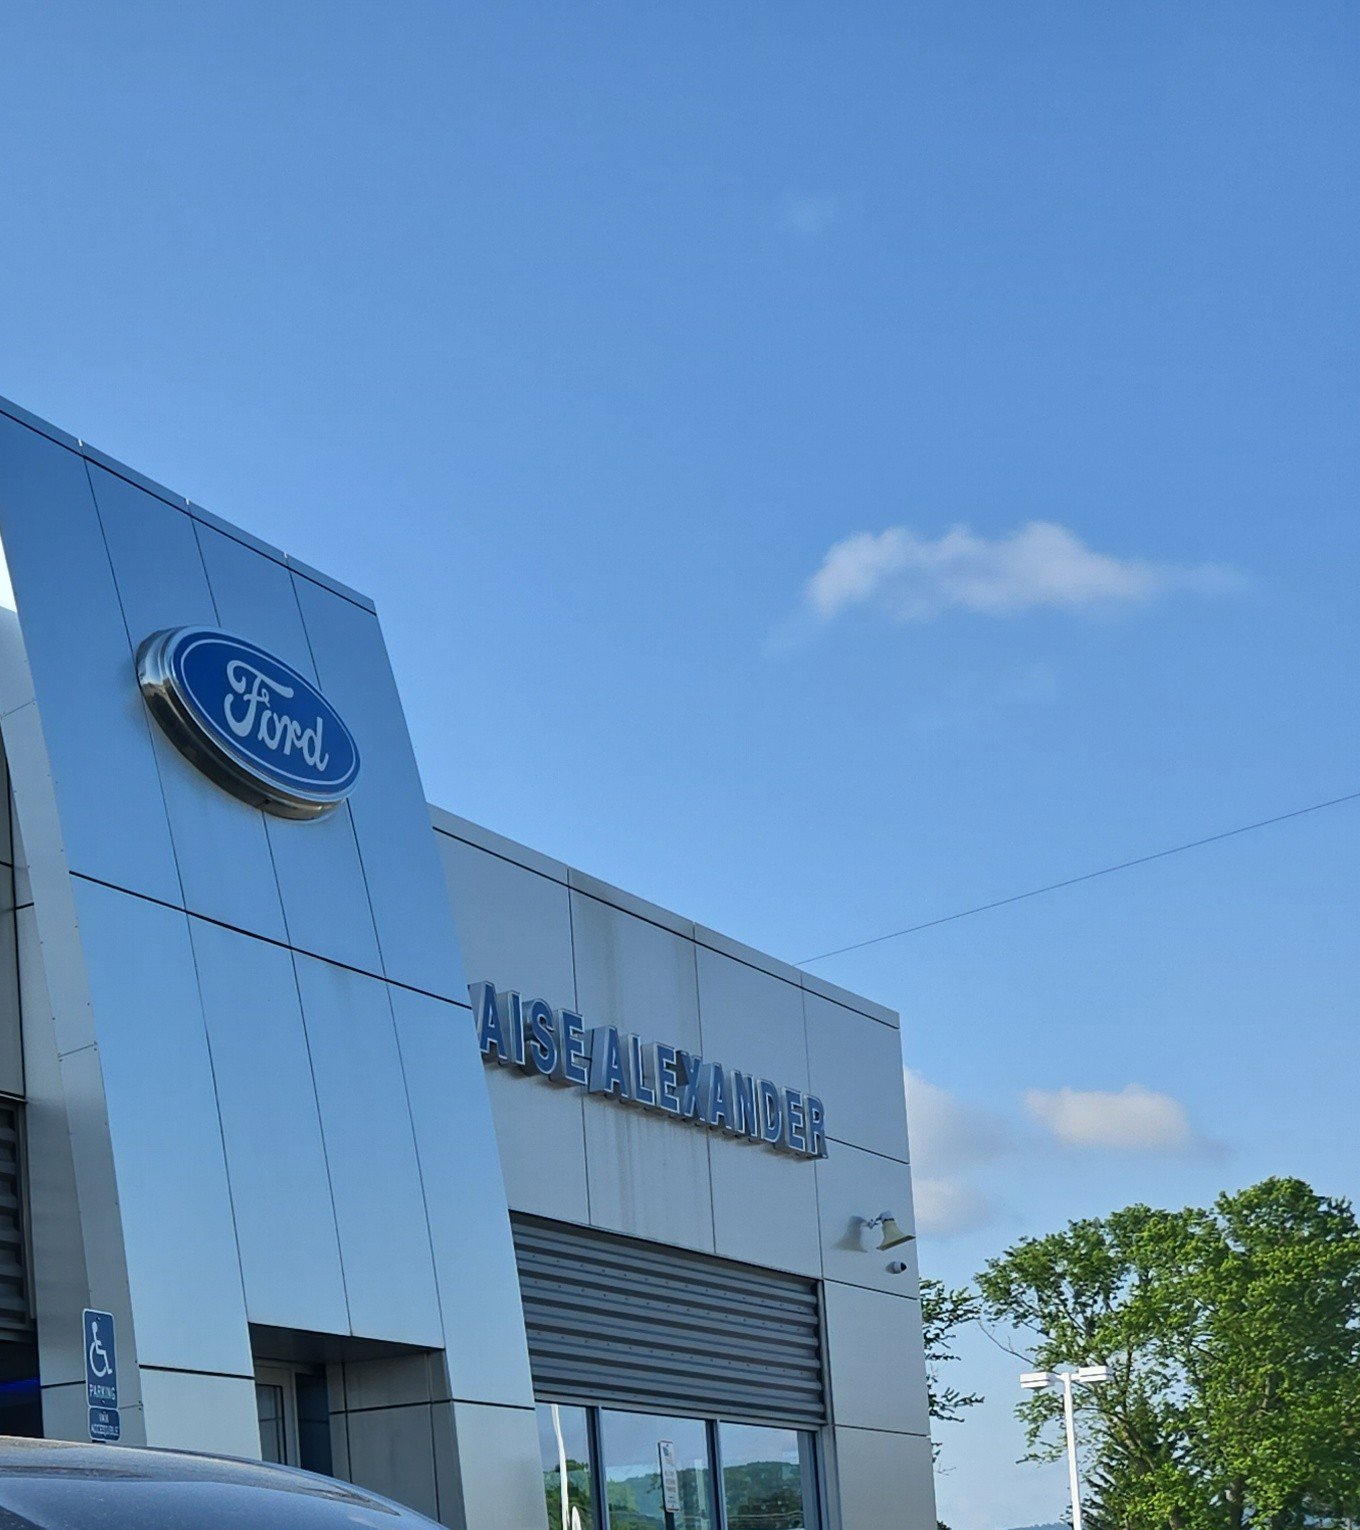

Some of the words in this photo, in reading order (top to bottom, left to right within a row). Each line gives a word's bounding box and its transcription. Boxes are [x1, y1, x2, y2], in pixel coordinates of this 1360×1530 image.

[224, 660, 329, 771] Ford
[592, 1026, 827, 1159] ALEXANDER
[89, 1383, 116, 1400] PARKING
